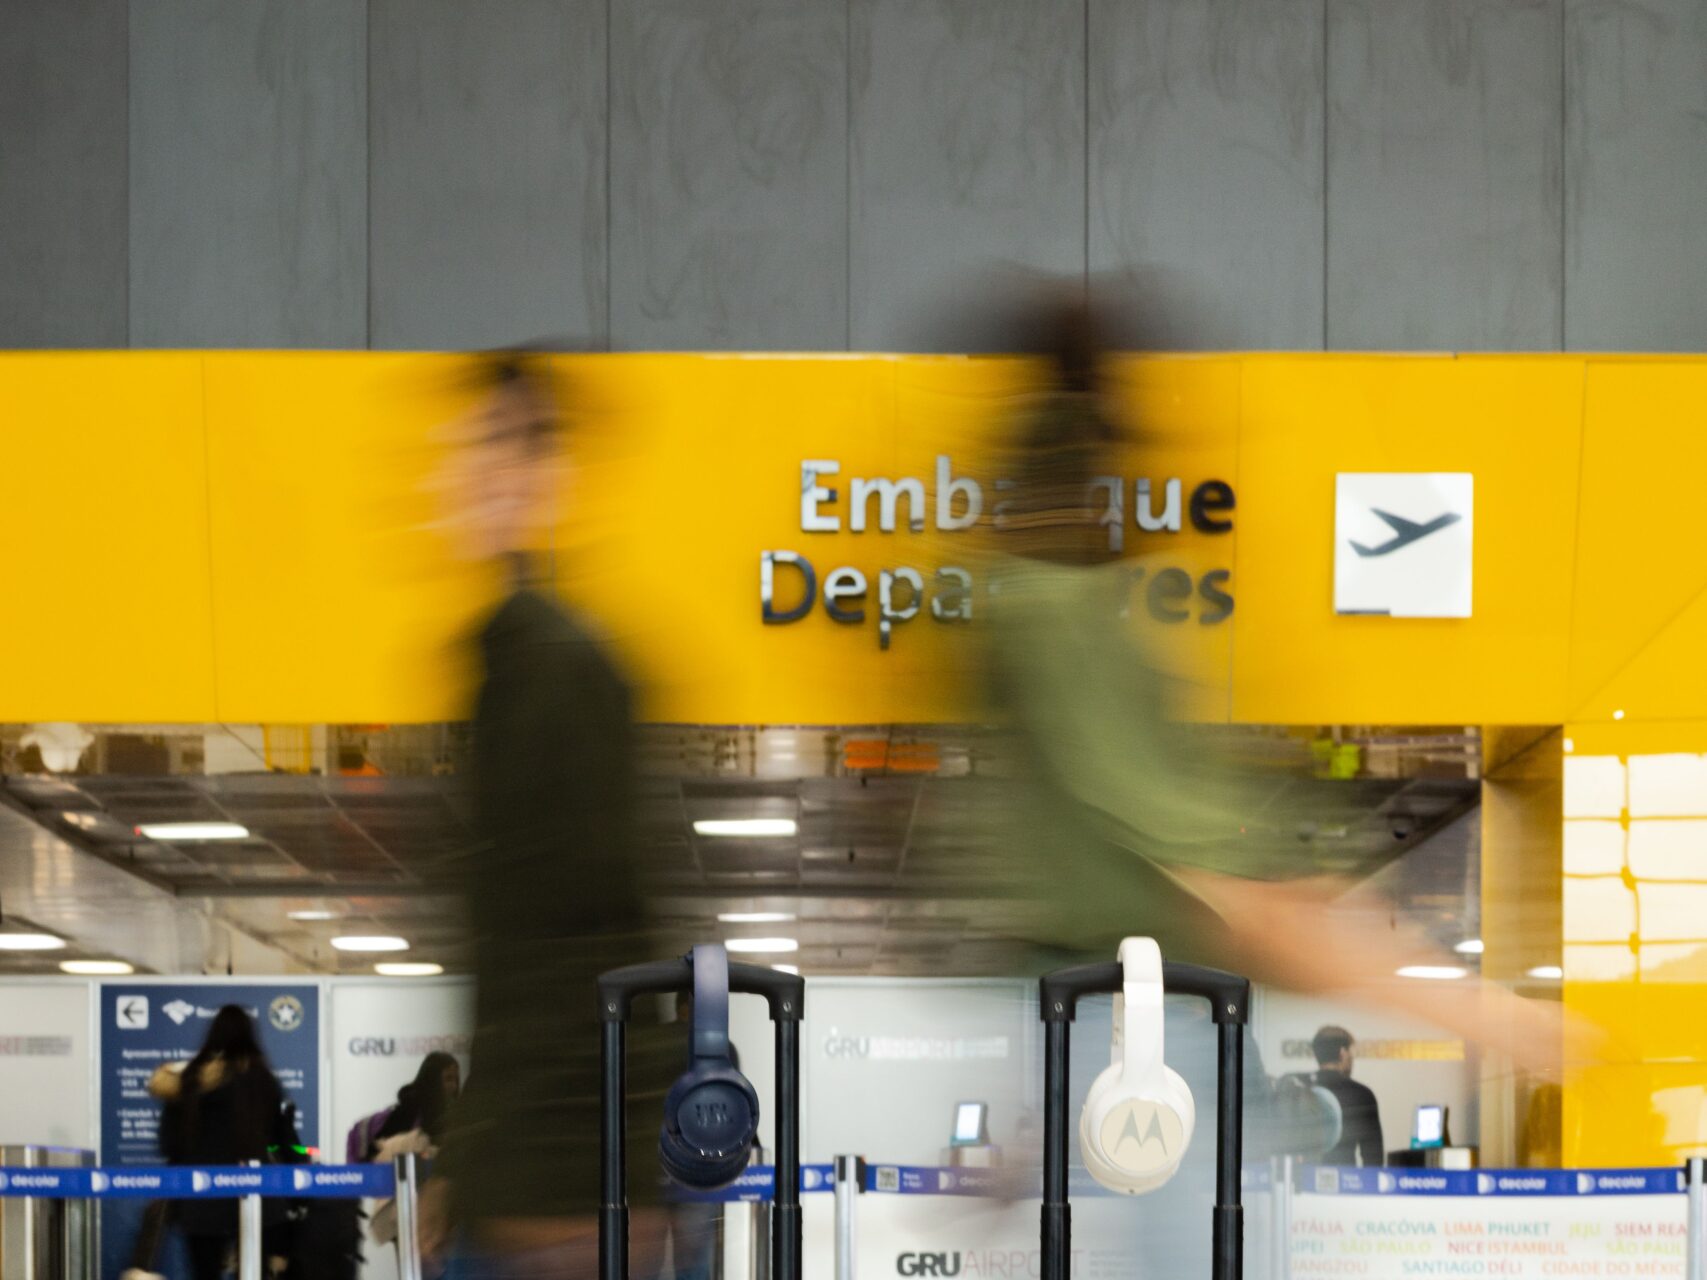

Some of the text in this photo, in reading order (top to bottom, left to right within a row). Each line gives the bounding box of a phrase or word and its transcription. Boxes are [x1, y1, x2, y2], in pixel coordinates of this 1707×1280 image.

[800, 455, 1236, 552] Embque
[760, 550, 1235, 650] Depares
[11, 1174, 60, 1188] decolar
[112, 1174, 161, 1188] decolar
[213, 1173, 262, 1187] decolar
[315, 1171, 363, 1185] decolar
[1398, 1175, 1447, 1189] decolar
[1498, 1176, 1547, 1190] decolar
[1598, 1175, 1646, 1189] decolar
[1355, 1217, 1437, 1236] CRACÓVIA
[1443, 1221, 1485, 1236] LIMA
[1487, 1221, 1550, 1236] PHUKET
[1614, 1222, 1652, 1237] SIEM
[1376, 1241, 1432, 1255] PAULO
[1446, 1241, 1485, 1255] NICE
[1487, 1241, 1568, 1256] ISTAMBUL
[1402, 1260, 1485, 1275] SANTIAGO
[1541, 1261, 1601, 1276] CIDADE
[1605, 1262, 1632, 1276] DO
